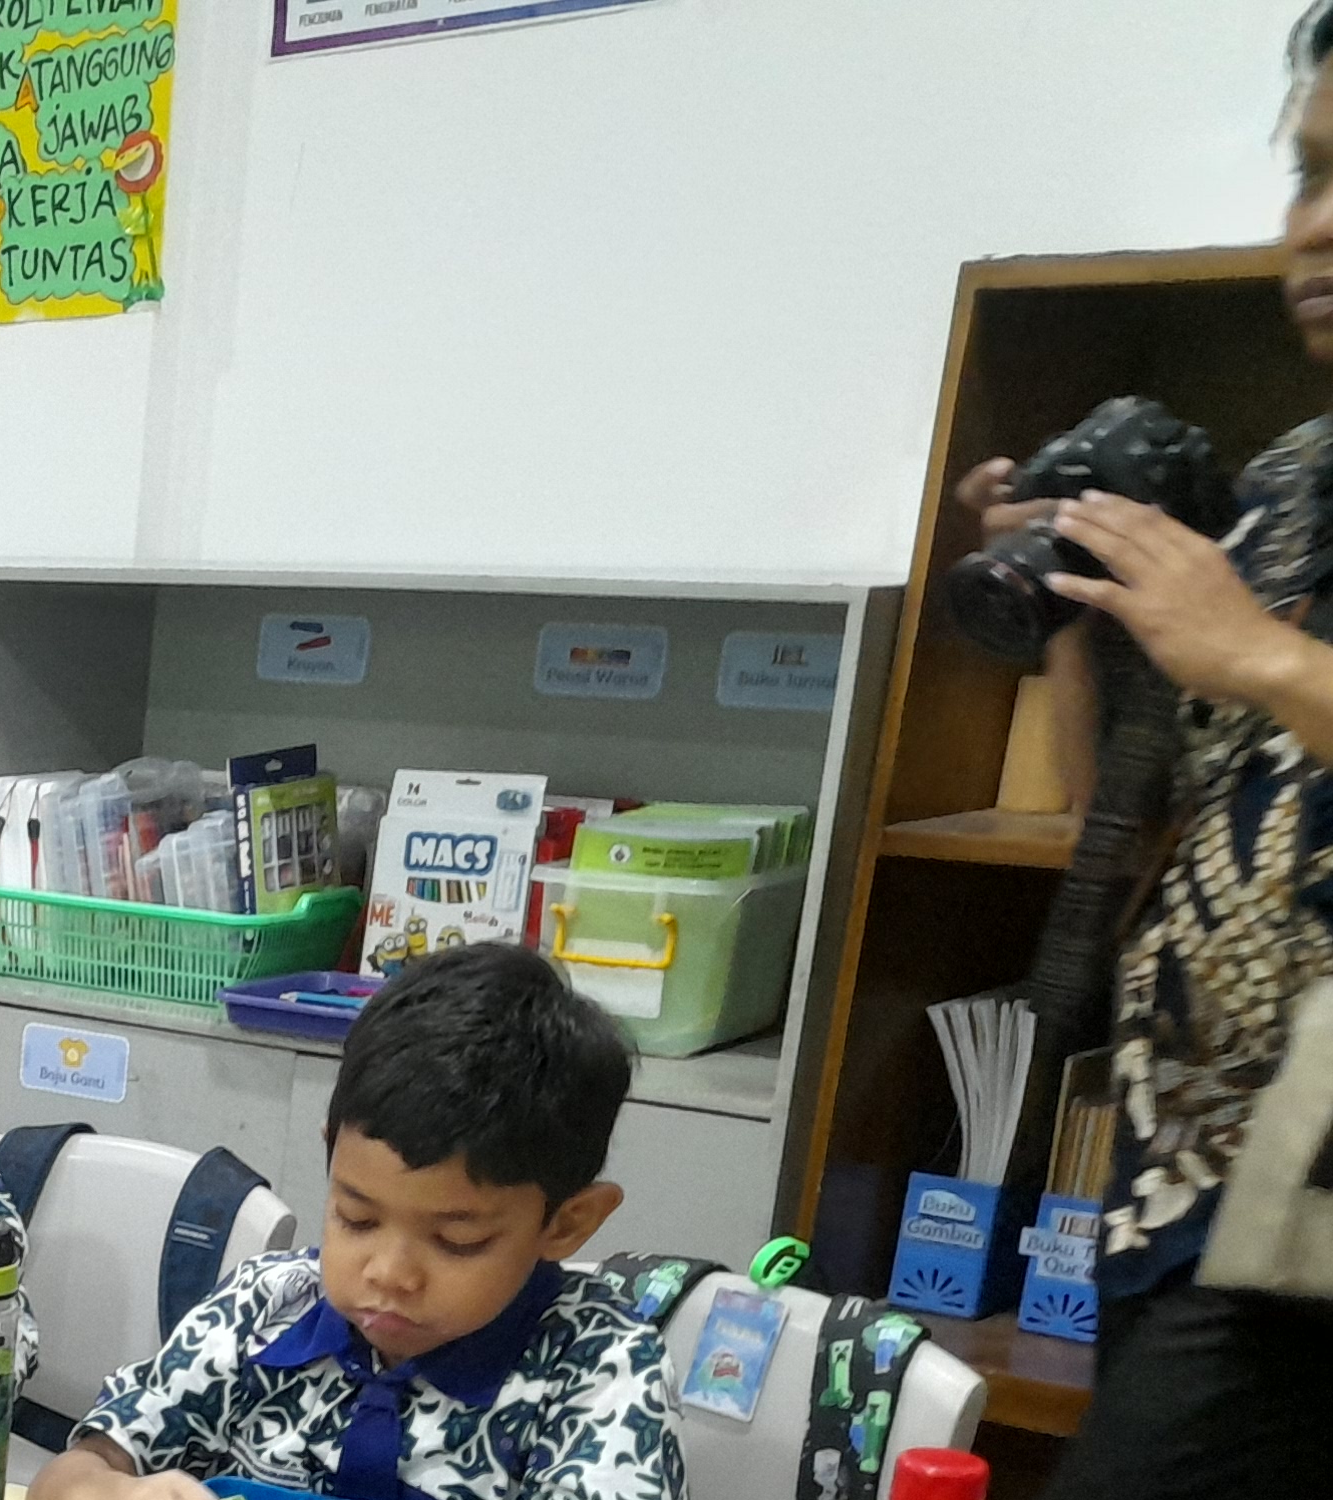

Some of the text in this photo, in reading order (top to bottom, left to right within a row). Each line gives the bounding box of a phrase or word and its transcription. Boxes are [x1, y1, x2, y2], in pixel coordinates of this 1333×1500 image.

[31, 33, 174, 101] TANGGUNG
[44, 94, 141, 155] JAWAB
[7, 166, 117, 229] KERJA
[1, 237, 128, 287] TUNTAS
[409, 836, 490, 870] MACS
[369, 902, 395, 928] ME
[922, 1196, 972, 1217] Buku
[907, 1219, 981, 1244] Gambar
[1027, 1235, 1075, 1256] Buku
